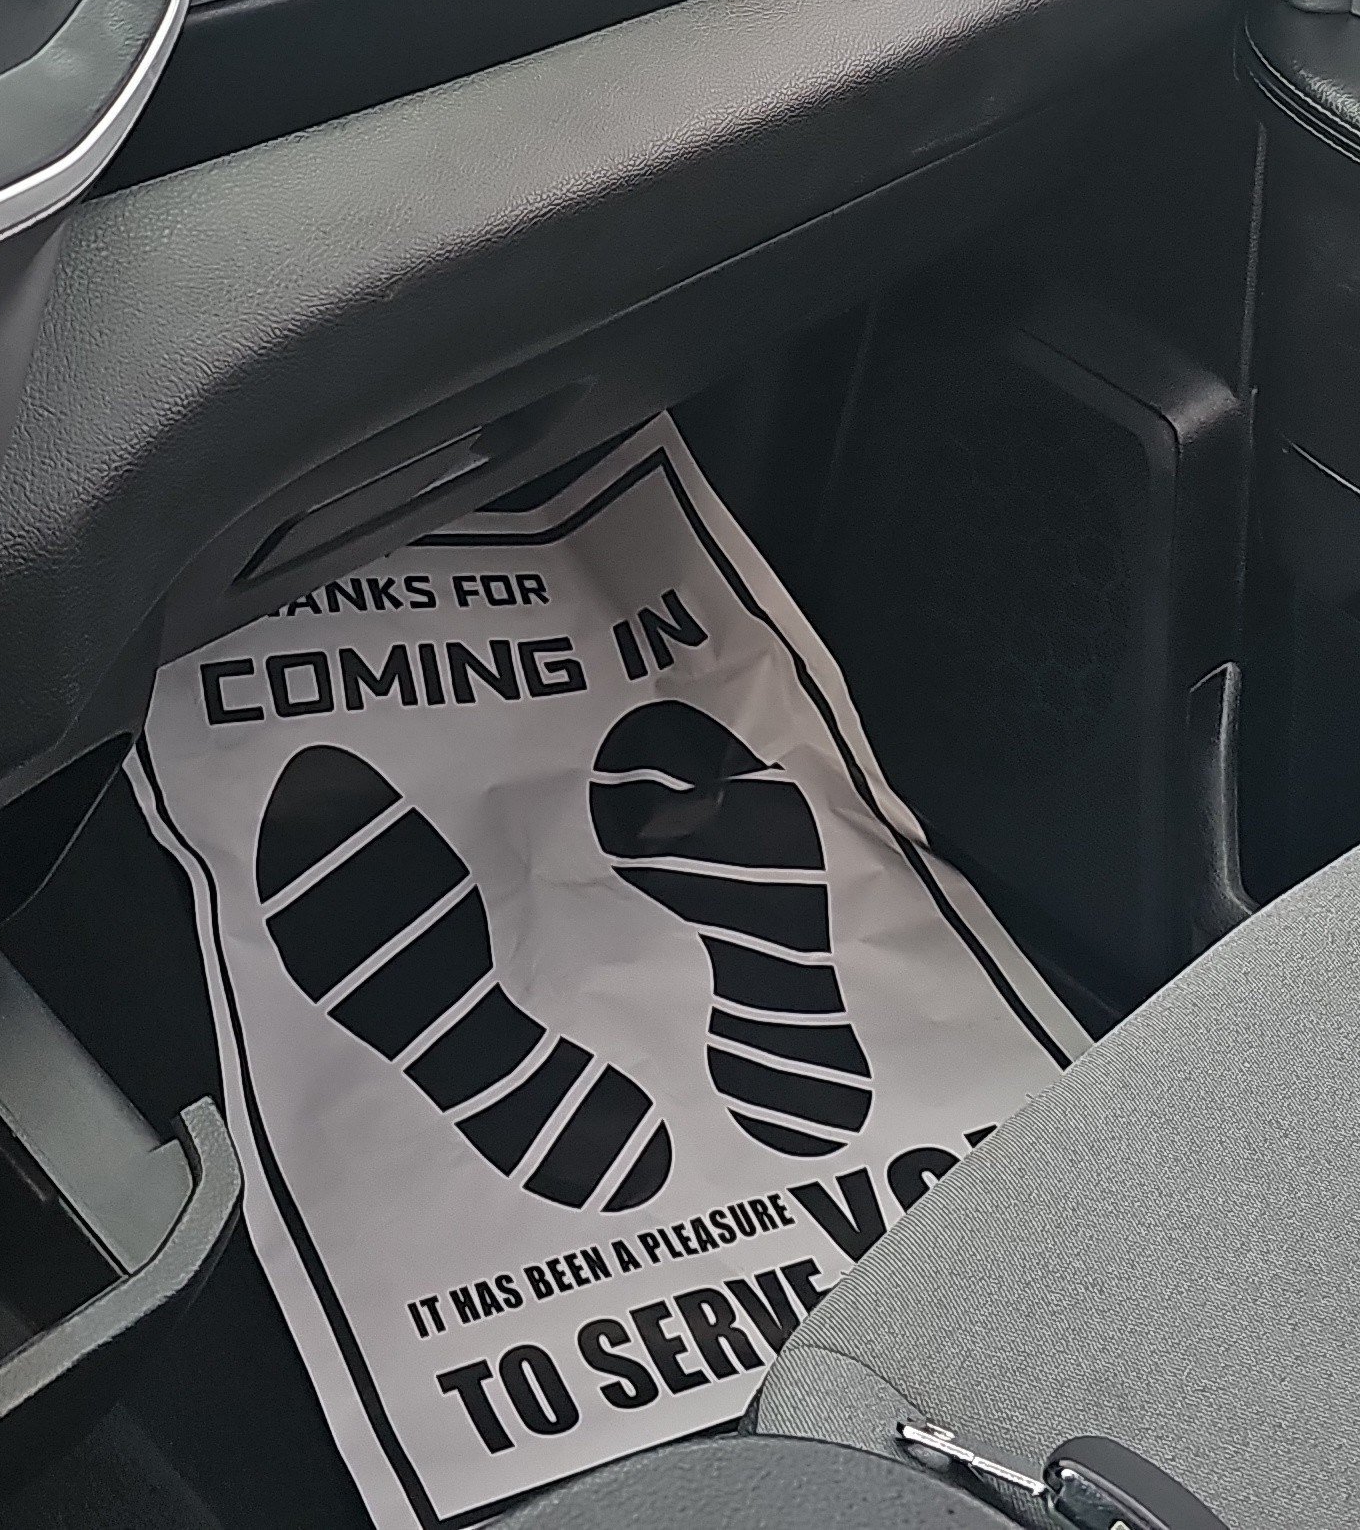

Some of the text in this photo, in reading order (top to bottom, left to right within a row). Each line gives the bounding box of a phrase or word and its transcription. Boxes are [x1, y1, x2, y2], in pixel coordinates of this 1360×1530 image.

[452, 573, 551, 608] FOR
[199, 588, 709, 726] COMING IN
[406, 1193, 796, 1339] IT HAS BEEN A PLEASURE
[435, 1343, 581, 1455] TO
